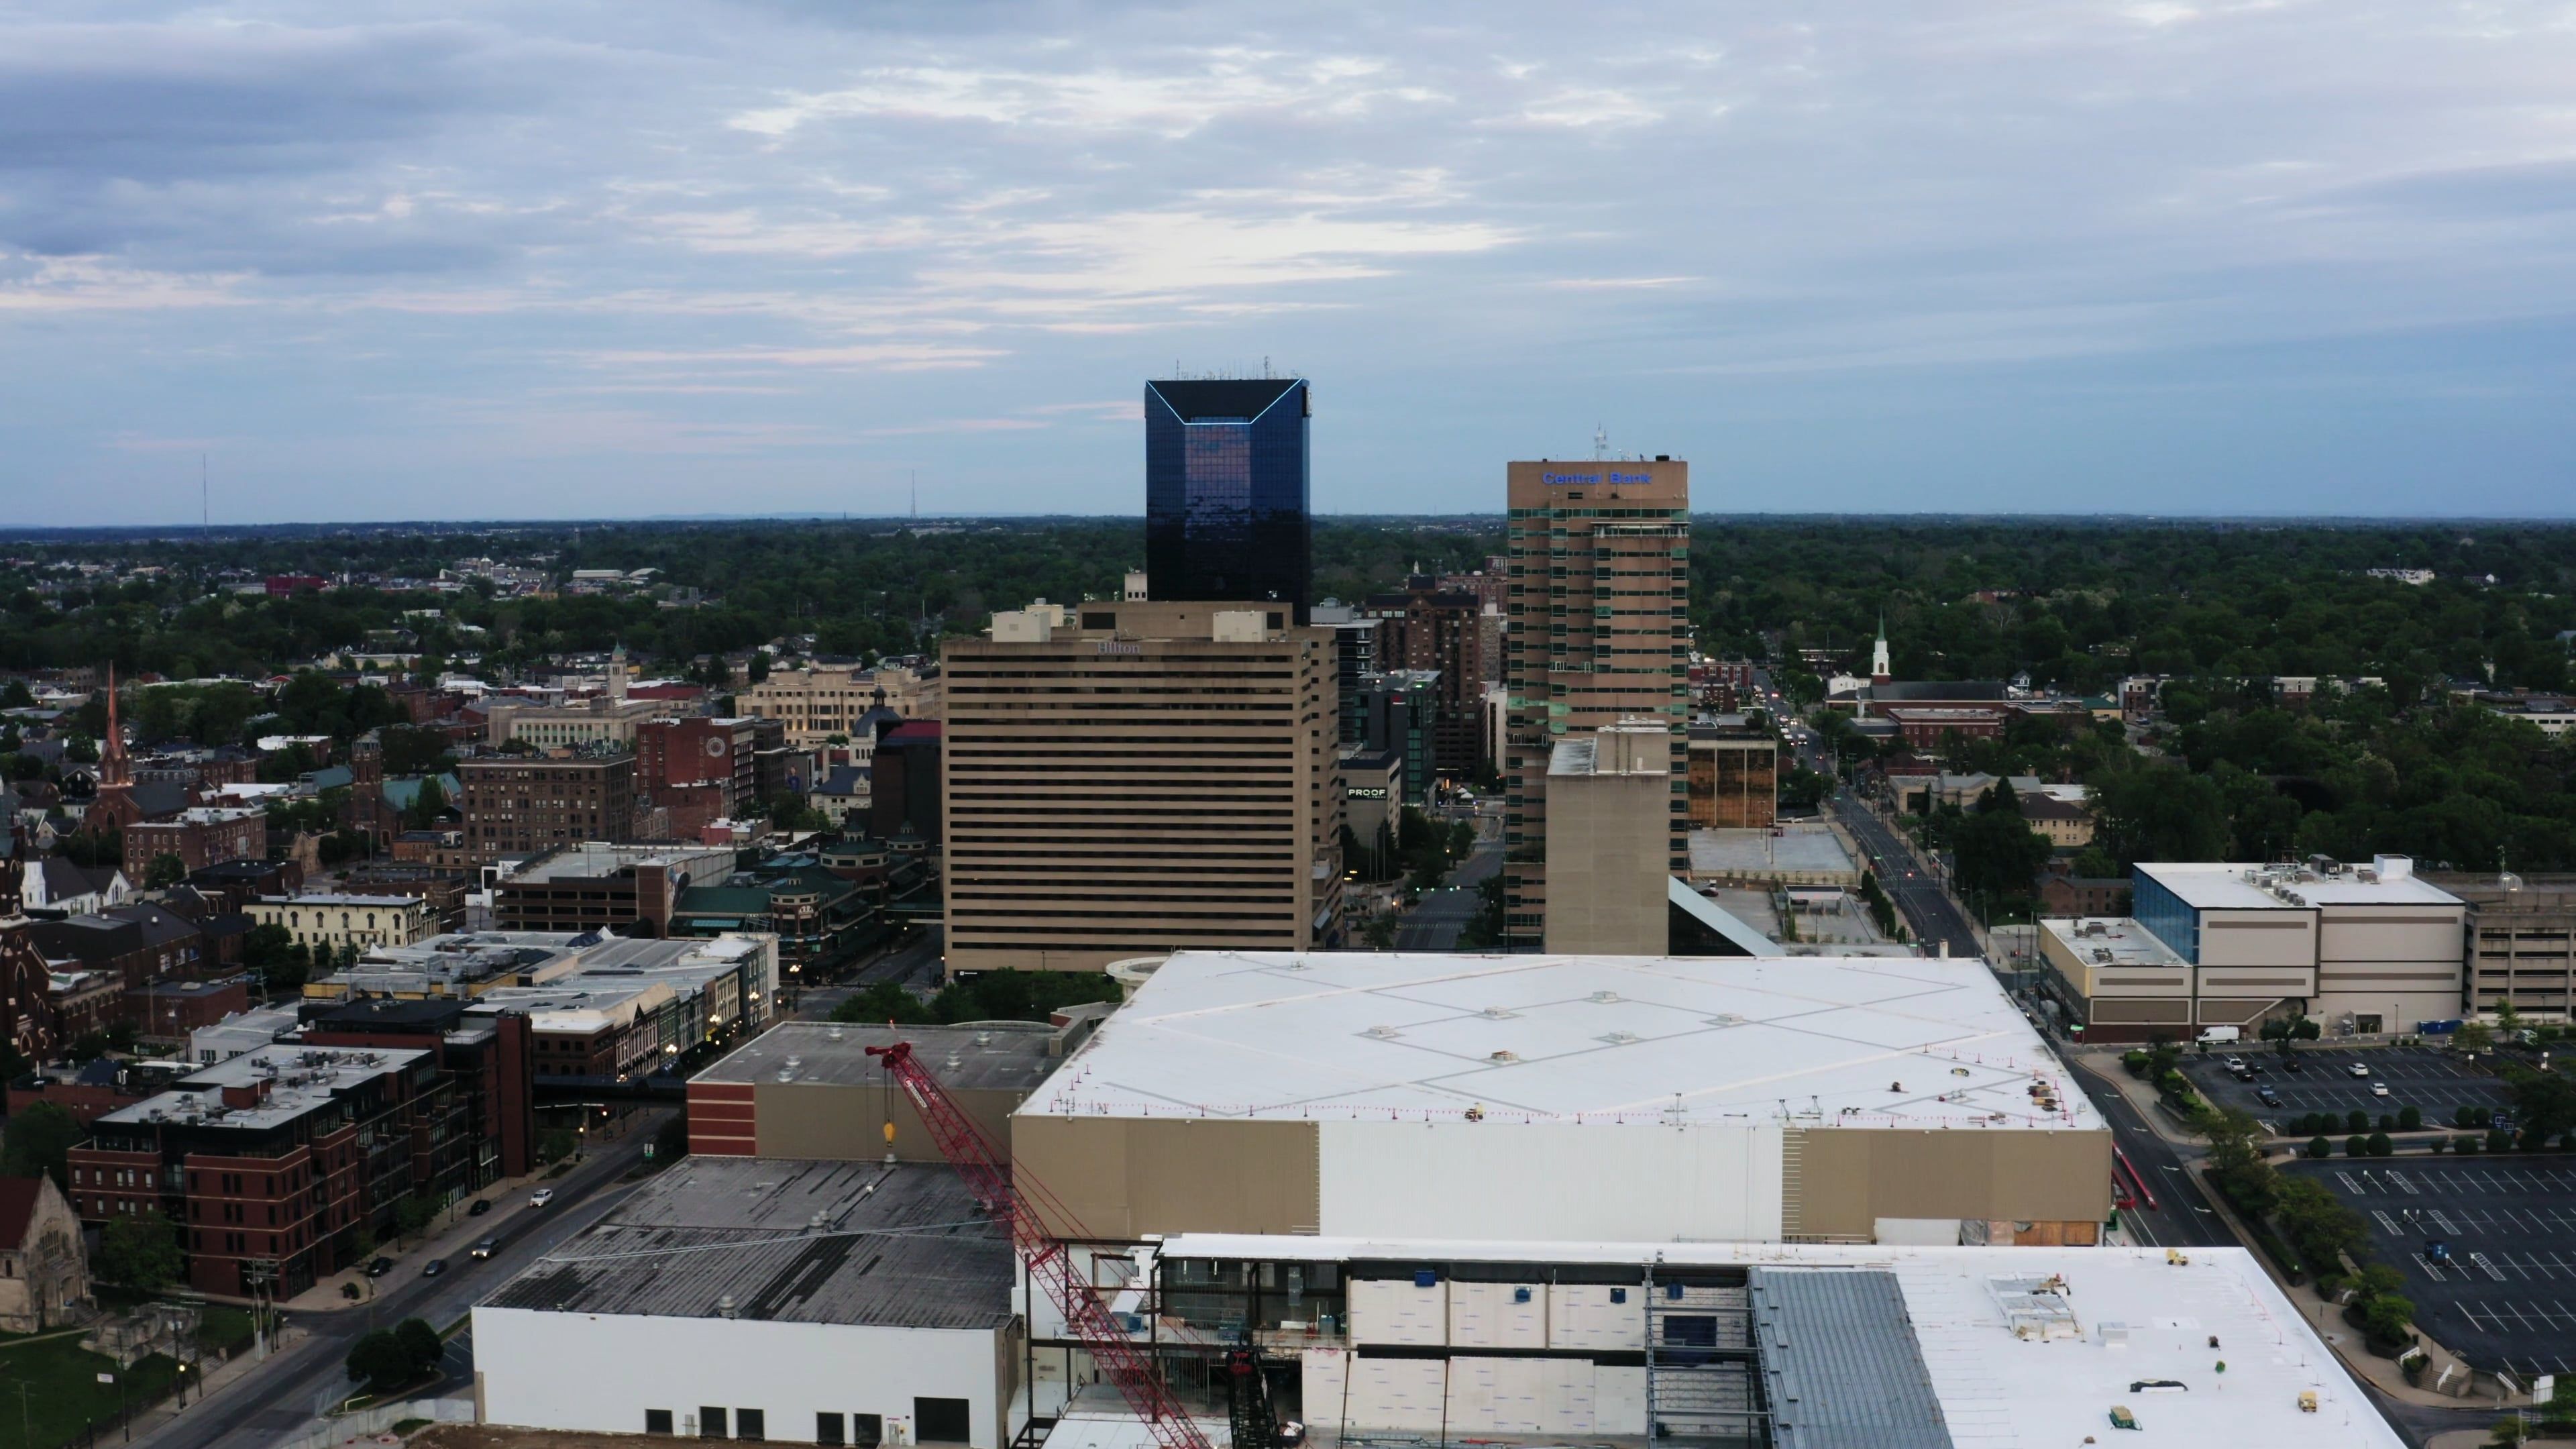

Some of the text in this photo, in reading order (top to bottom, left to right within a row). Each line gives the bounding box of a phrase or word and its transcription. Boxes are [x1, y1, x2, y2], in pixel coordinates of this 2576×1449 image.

[1542, 472, 1652, 484] Central Bank
[1097, 640, 1140, 654] Hilton
